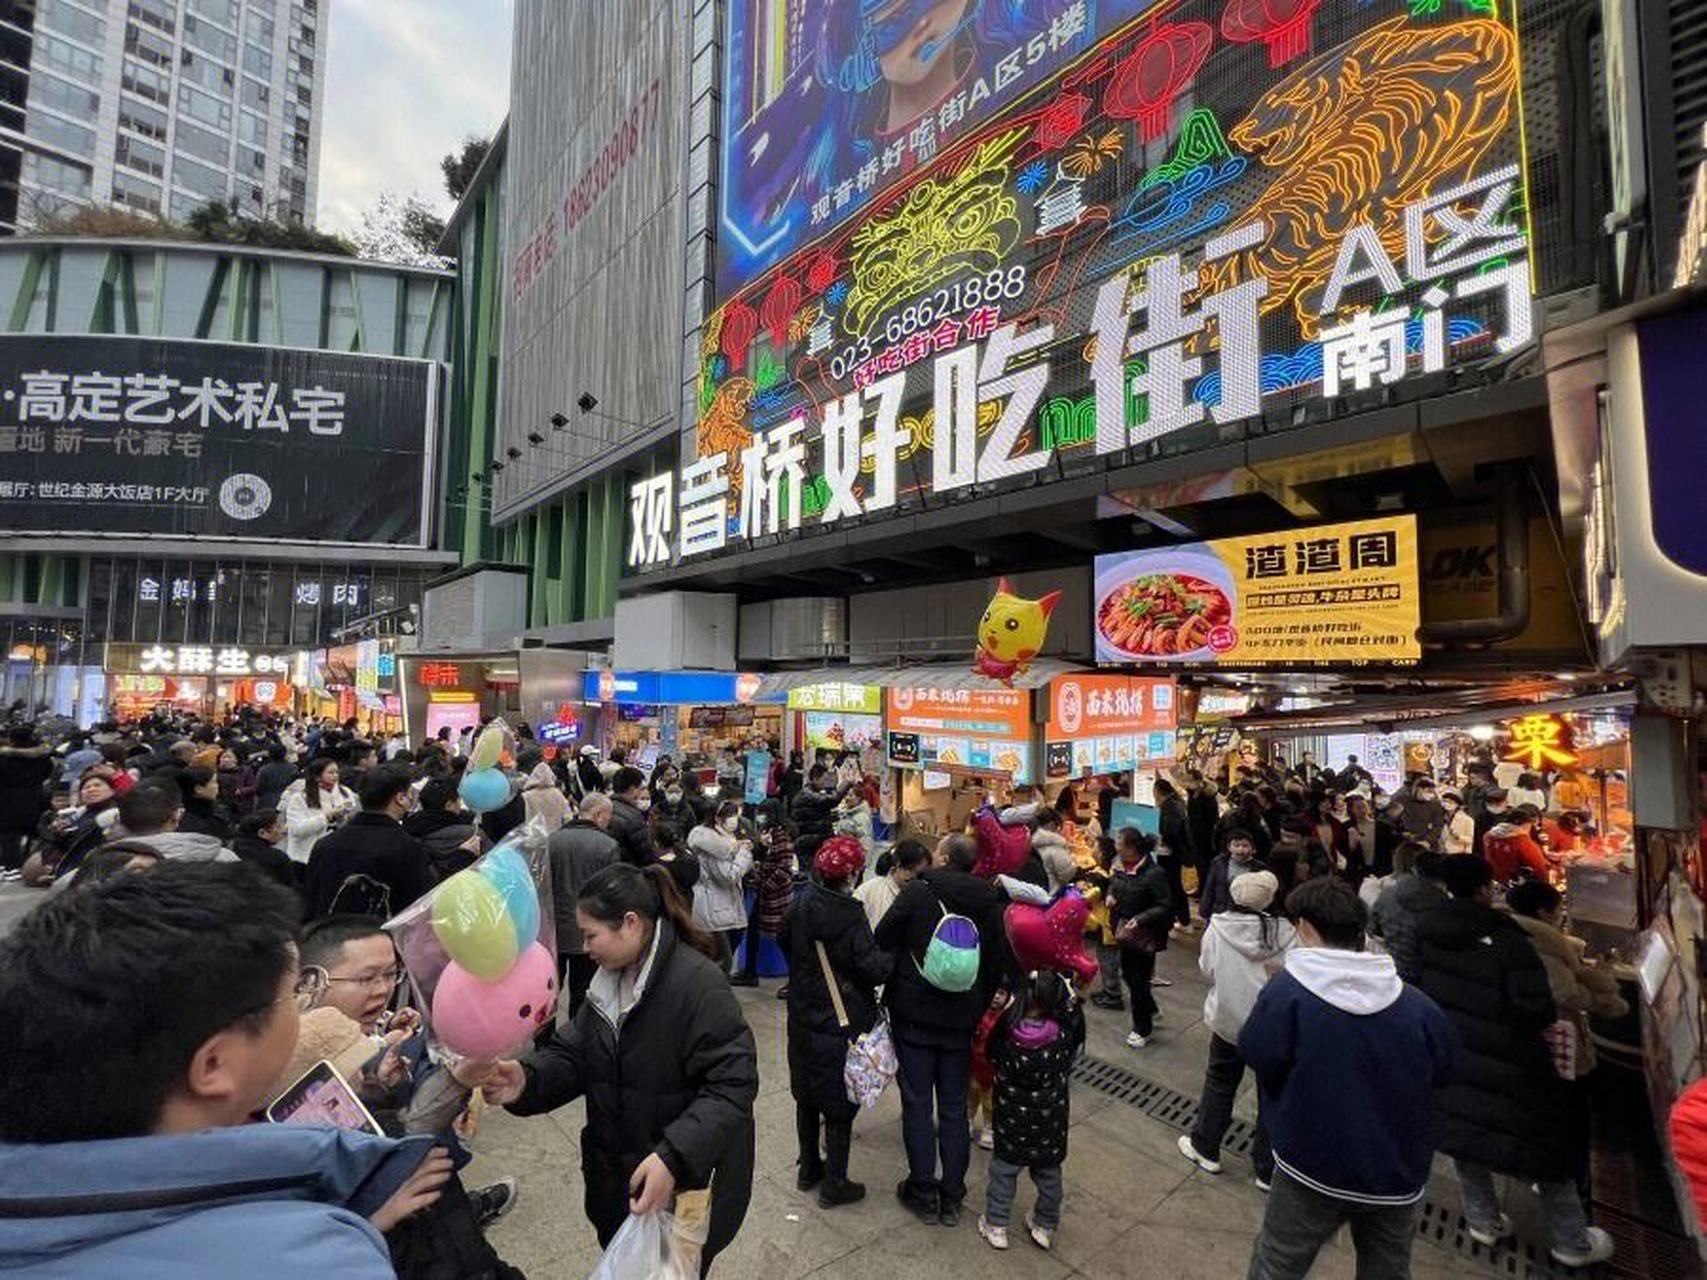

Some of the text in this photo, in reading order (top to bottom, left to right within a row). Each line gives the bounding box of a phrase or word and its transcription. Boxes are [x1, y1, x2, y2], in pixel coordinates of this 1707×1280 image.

[811, 2, 1086, 225] 观音桥好吃街A区5楼
[1319, 163, 1529, 316] A区
[829, 265, 1026, 381] 023-68621888
[854, 304, 1002, 392] 好吃街合作
[1319, 258, 1535, 399] 南门
[629, 220, 1270, 568] 观音桥好吃街
[1502, 714, 1579, 770] 栗
